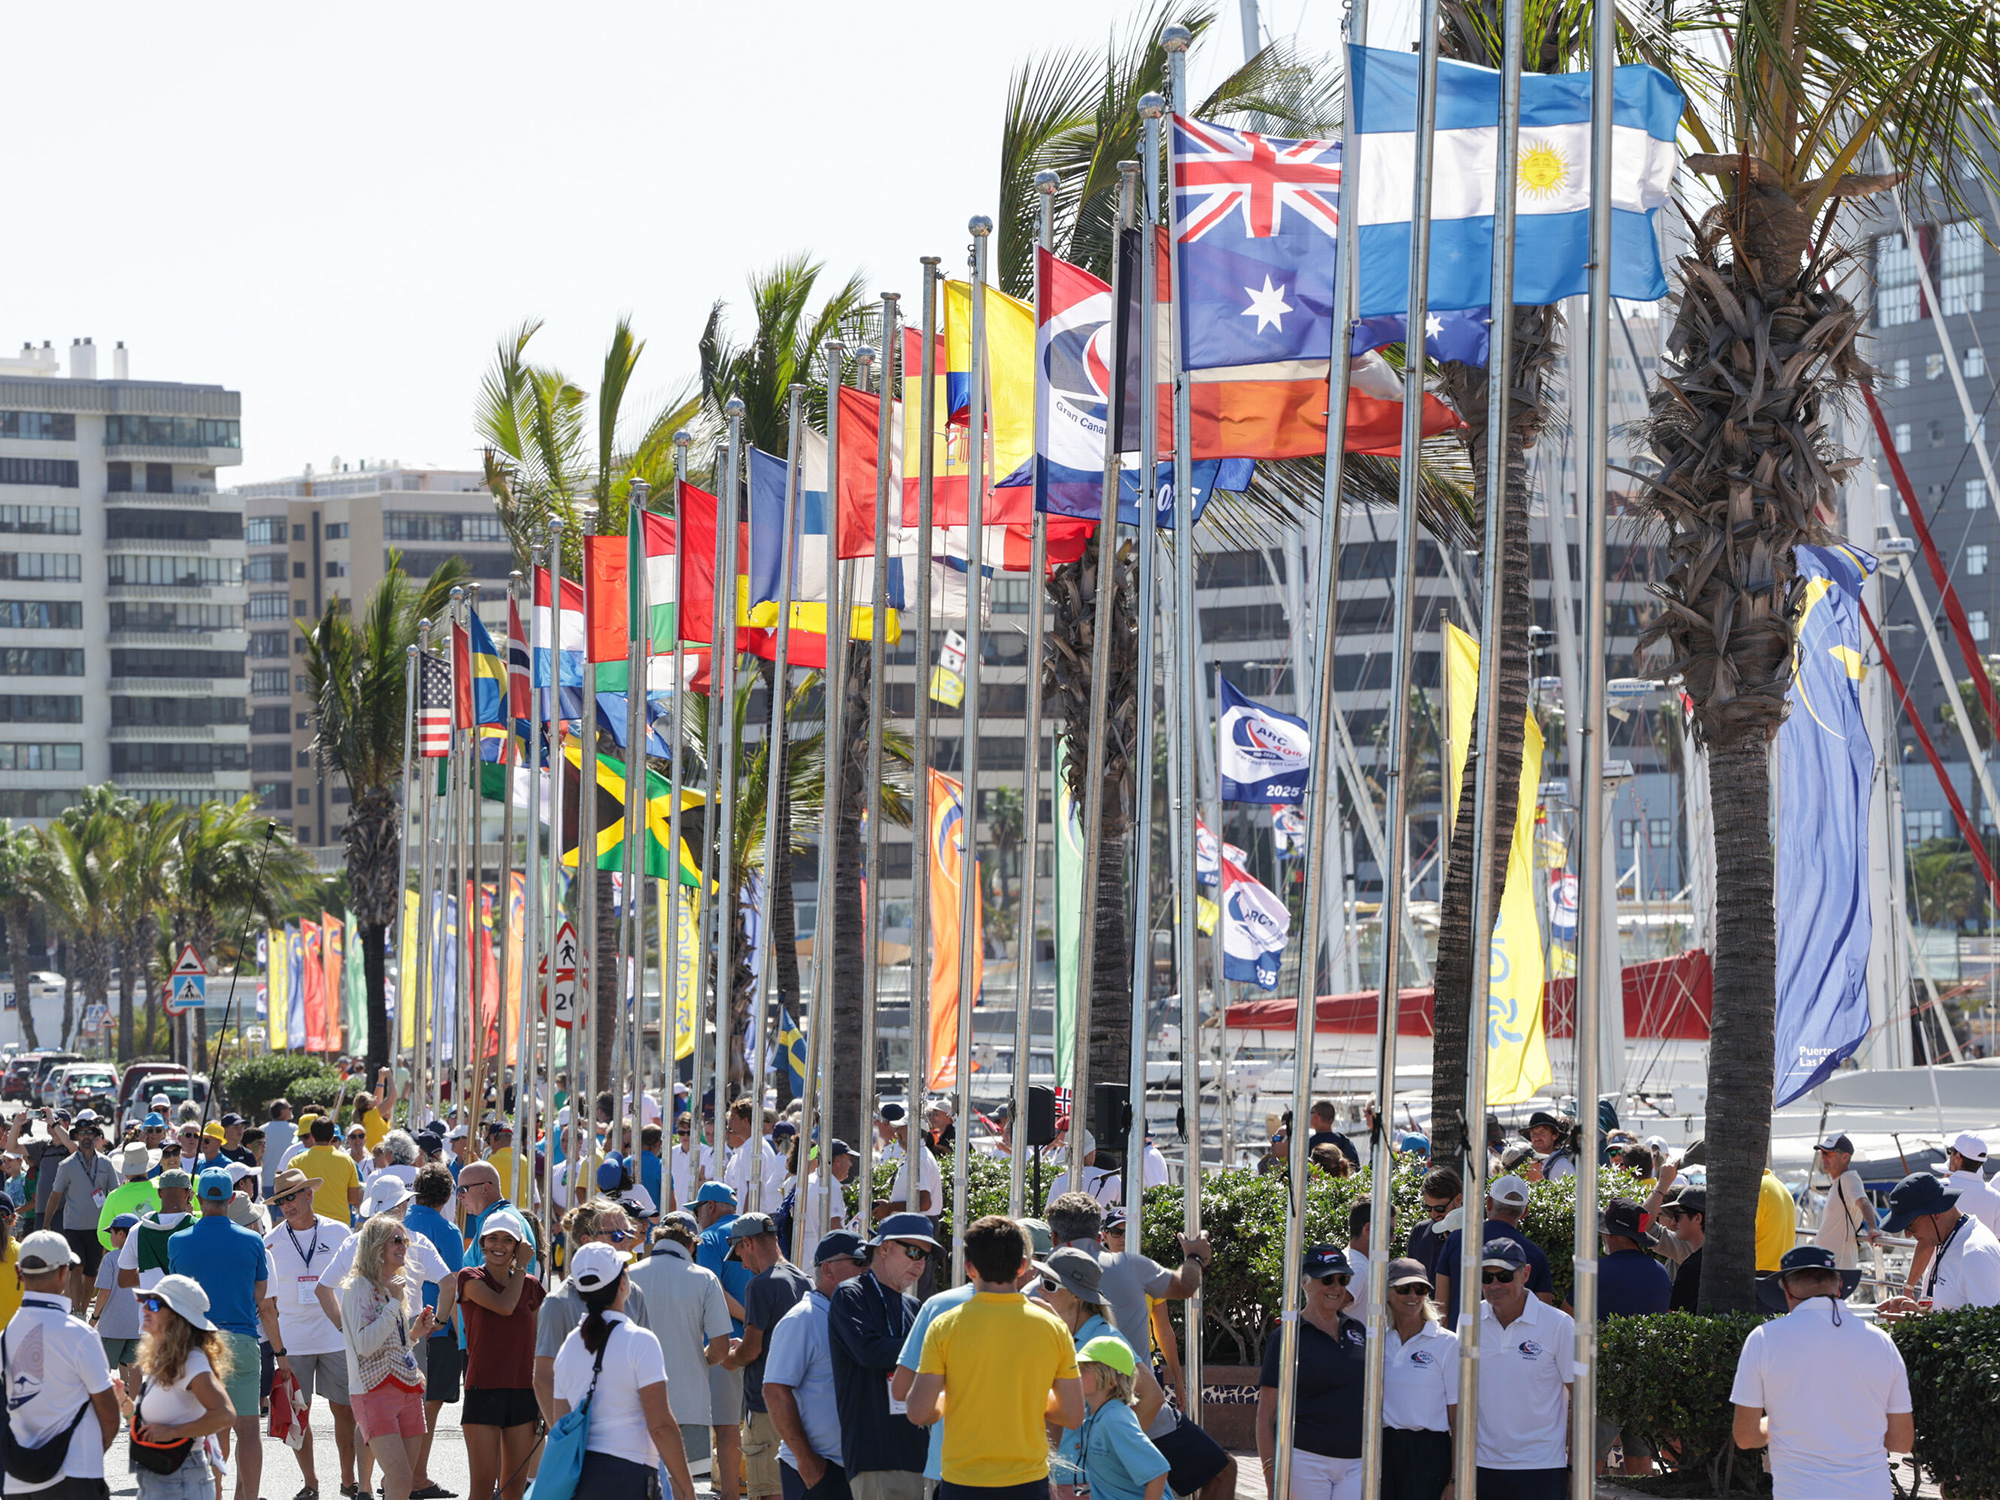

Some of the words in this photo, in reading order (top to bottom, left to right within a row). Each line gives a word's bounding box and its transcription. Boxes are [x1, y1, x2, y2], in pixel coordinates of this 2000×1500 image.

[1056, 401, 1078, 423] Gran
[1257, 727, 1288, 746] ARC
[1273, 745, 1302, 757] 40th
[1266, 784, 1301, 797] 2025
[6, 993, 15, 1006] P
[1800, 1057, 1817, 1067] Las
